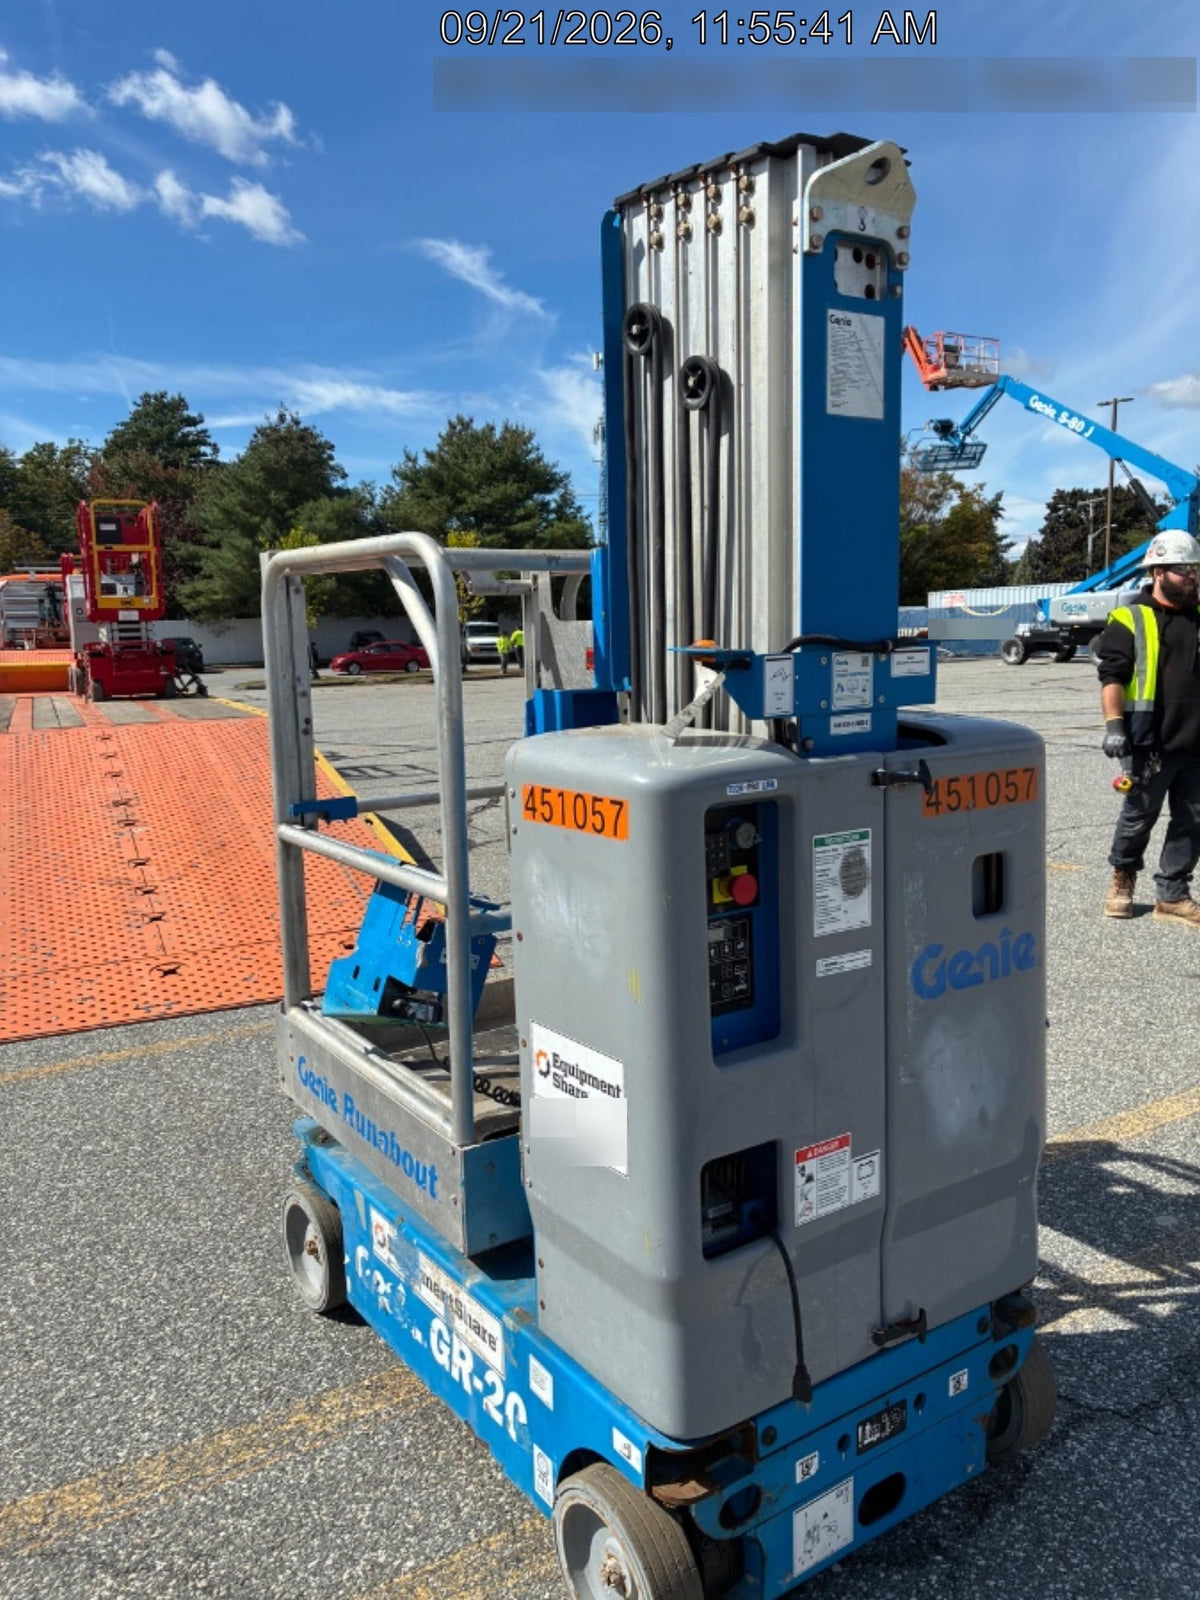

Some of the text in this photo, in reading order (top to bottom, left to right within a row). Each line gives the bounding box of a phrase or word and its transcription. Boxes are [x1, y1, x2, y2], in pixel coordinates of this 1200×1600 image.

[1029, 393, 1057, 418] Genie
[524, 785, 624, 836] 451057
[926, 768, 1035, 813] 451057
[911, 926, 1036, 1000] Genie
[552, 1051, 622, 1099] Equipment
[552, 1073, 589, 1099] Share
[297, 1055, 438, 1199] Genie Runabout
